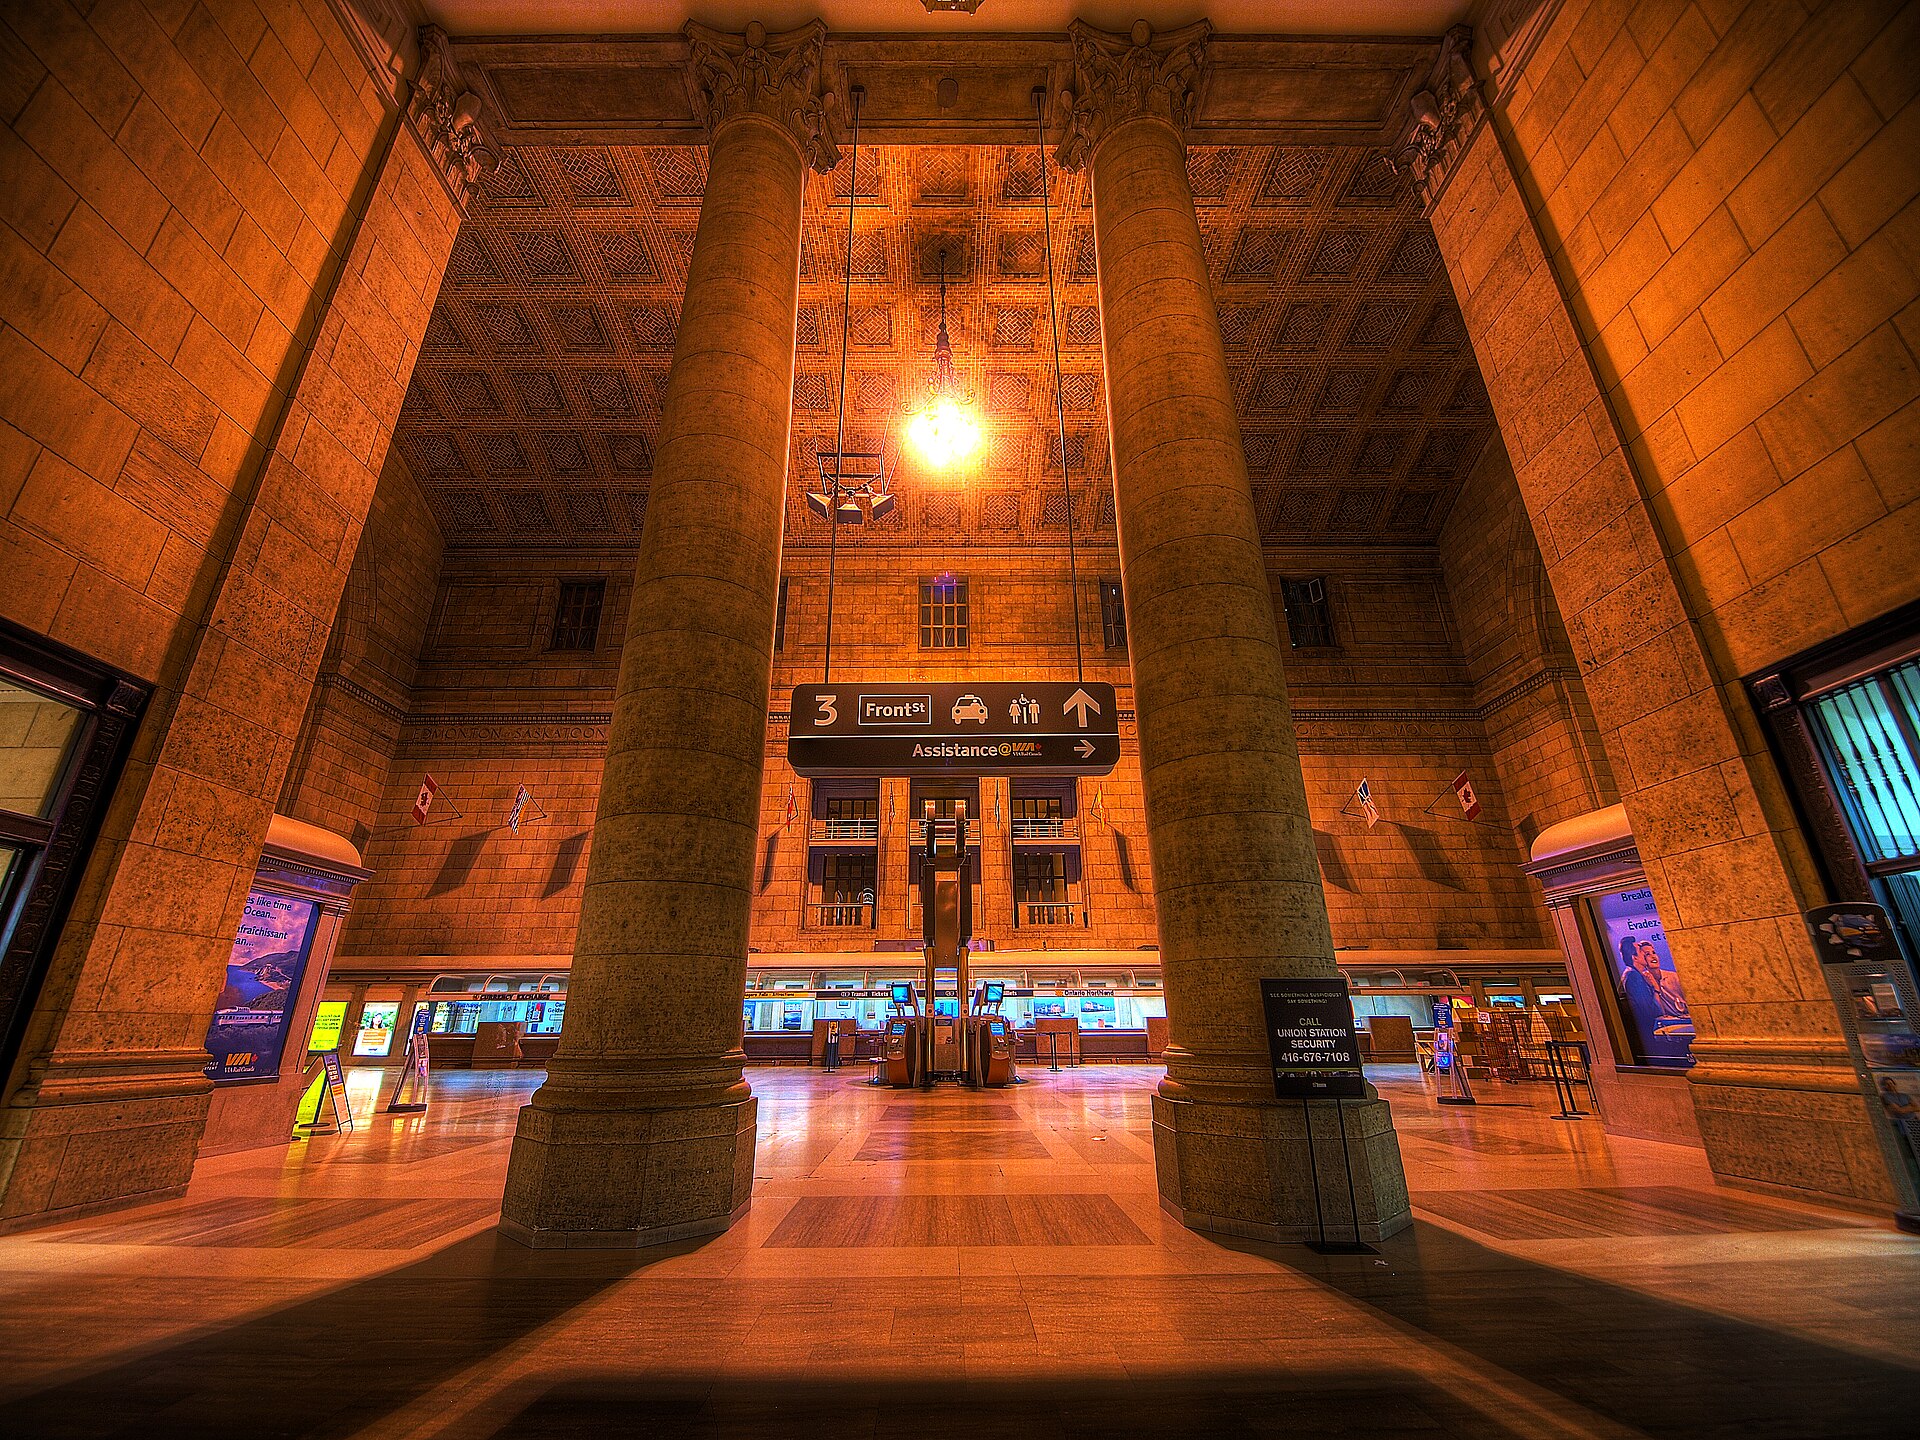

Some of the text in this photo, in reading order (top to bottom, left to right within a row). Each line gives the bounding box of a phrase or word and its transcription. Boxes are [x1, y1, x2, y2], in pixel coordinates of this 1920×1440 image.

[814, 694, 838, 726] 3
[866, 702, 912, 717] Front
[413, 727, 607, 739] EDMONTON SASKATOON
[256, 896, 272, 907] like
[273, 900, 292, 911] time
[1651, 932, 1661, 941] et
[1299, 1017, 1322, 1026] CALL
[1277, 1028, 1347, 1038] UNION STATION
[1291, 1039, 1336, 1049] SECURITY
[225, 1052, 252, 1066] VIA
[1281, 1052, 1350, 1063] 416-676-7108
